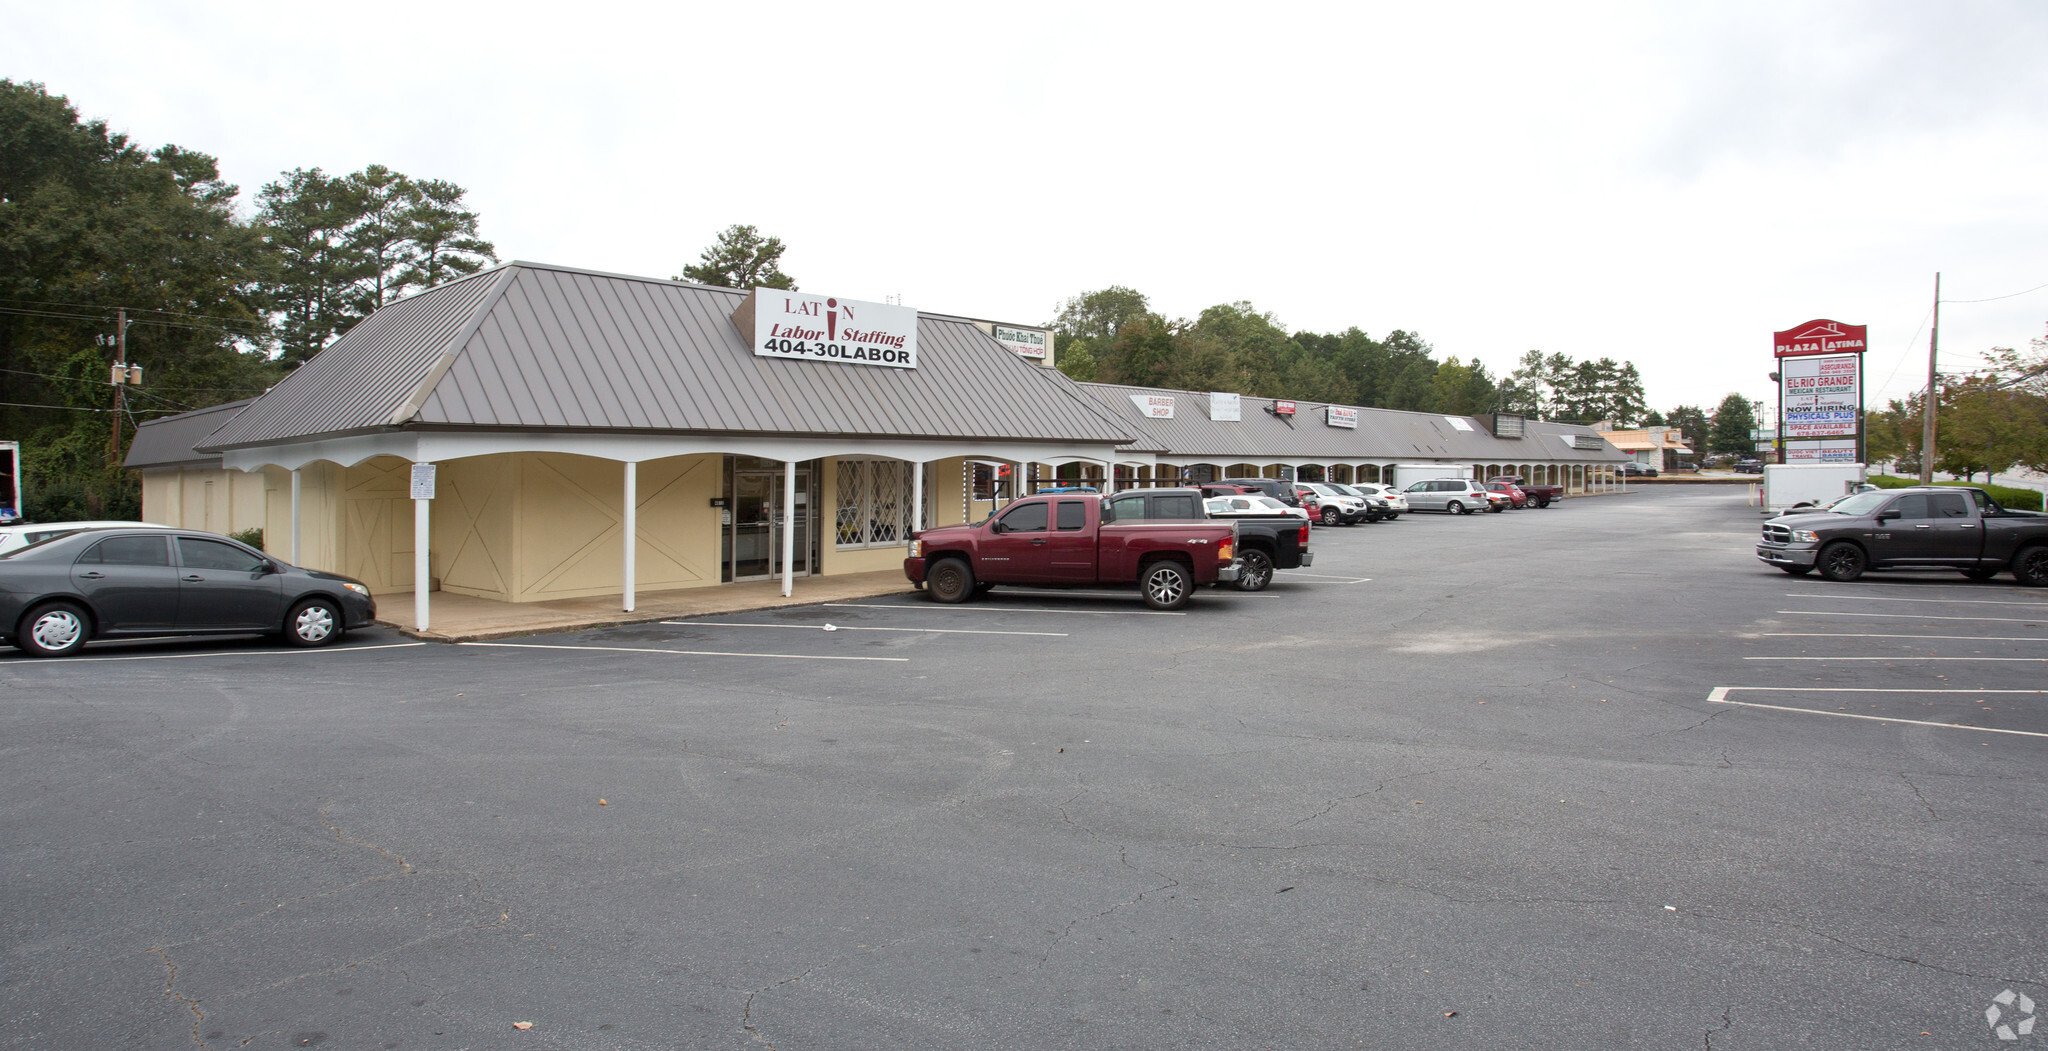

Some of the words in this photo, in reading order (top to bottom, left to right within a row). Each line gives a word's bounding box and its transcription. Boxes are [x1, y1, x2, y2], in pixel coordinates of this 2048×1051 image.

[770, 322, 825, 342] Labor
[841, 327, 906, 349] Staffing
[764, 338, 910, 364] 404-30LABOR
[1776, 342, 1819, 353] PLAZA
[1821, 363, 1855, 371] ASEGURANZA
[1800, 378, 1815, 387] RIO
[1817, 376, 1854, 386] GRANDE
[1148, 397, 1174, 407] BARBER
[1152, 408, 1169, 417] SHOP
[1787, 412, 1830, 420] PHYSICALS
[1834, 411, 1854, 419] PLUS
